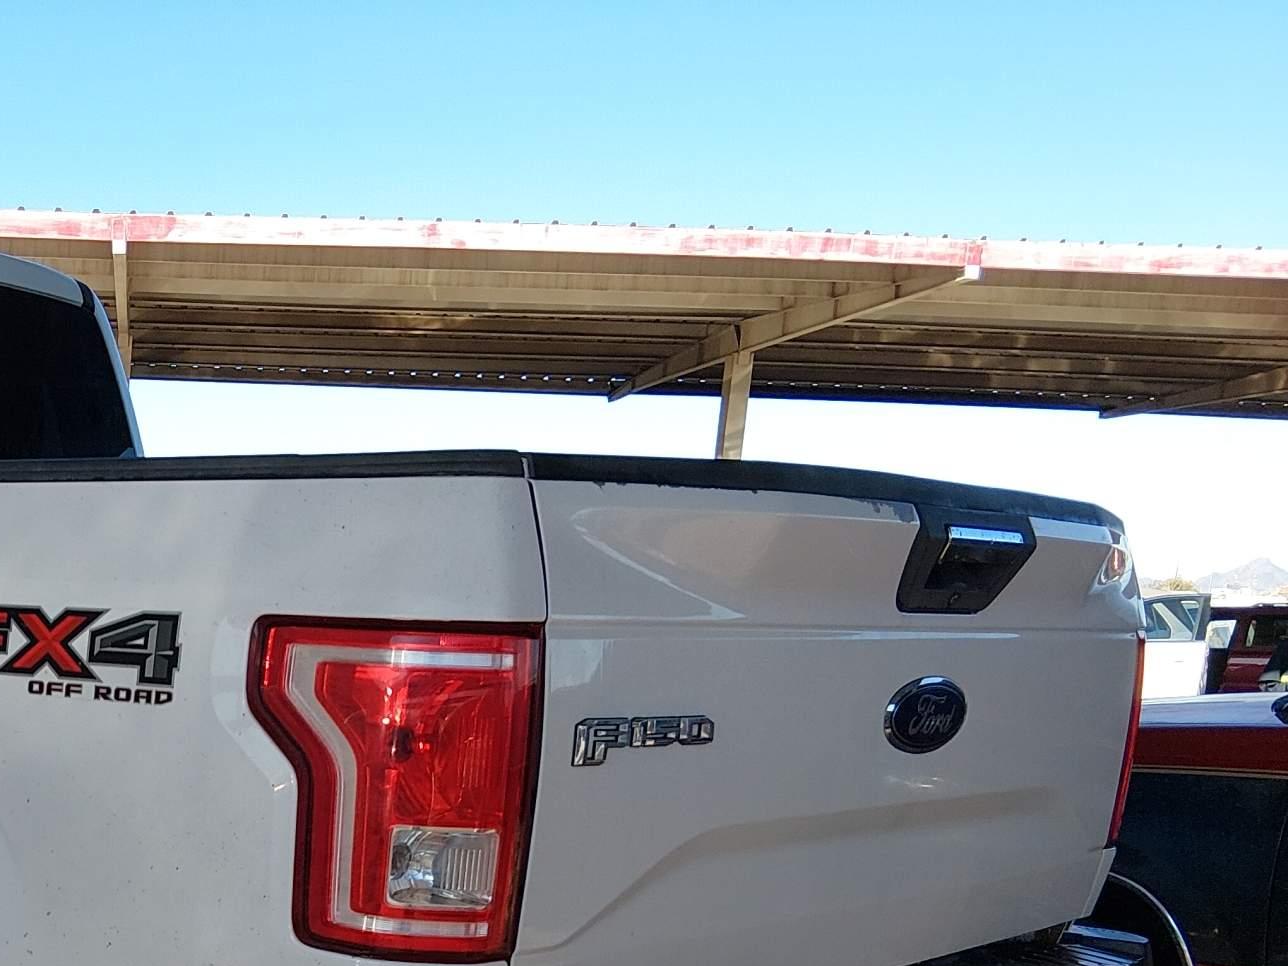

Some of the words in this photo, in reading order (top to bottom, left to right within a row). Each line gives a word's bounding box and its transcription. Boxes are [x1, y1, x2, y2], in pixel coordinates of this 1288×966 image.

[28, 680, 82, 698] OFF
[94, 685, 173, 705] ROAD
[908, 694, 957, 735] Ford
